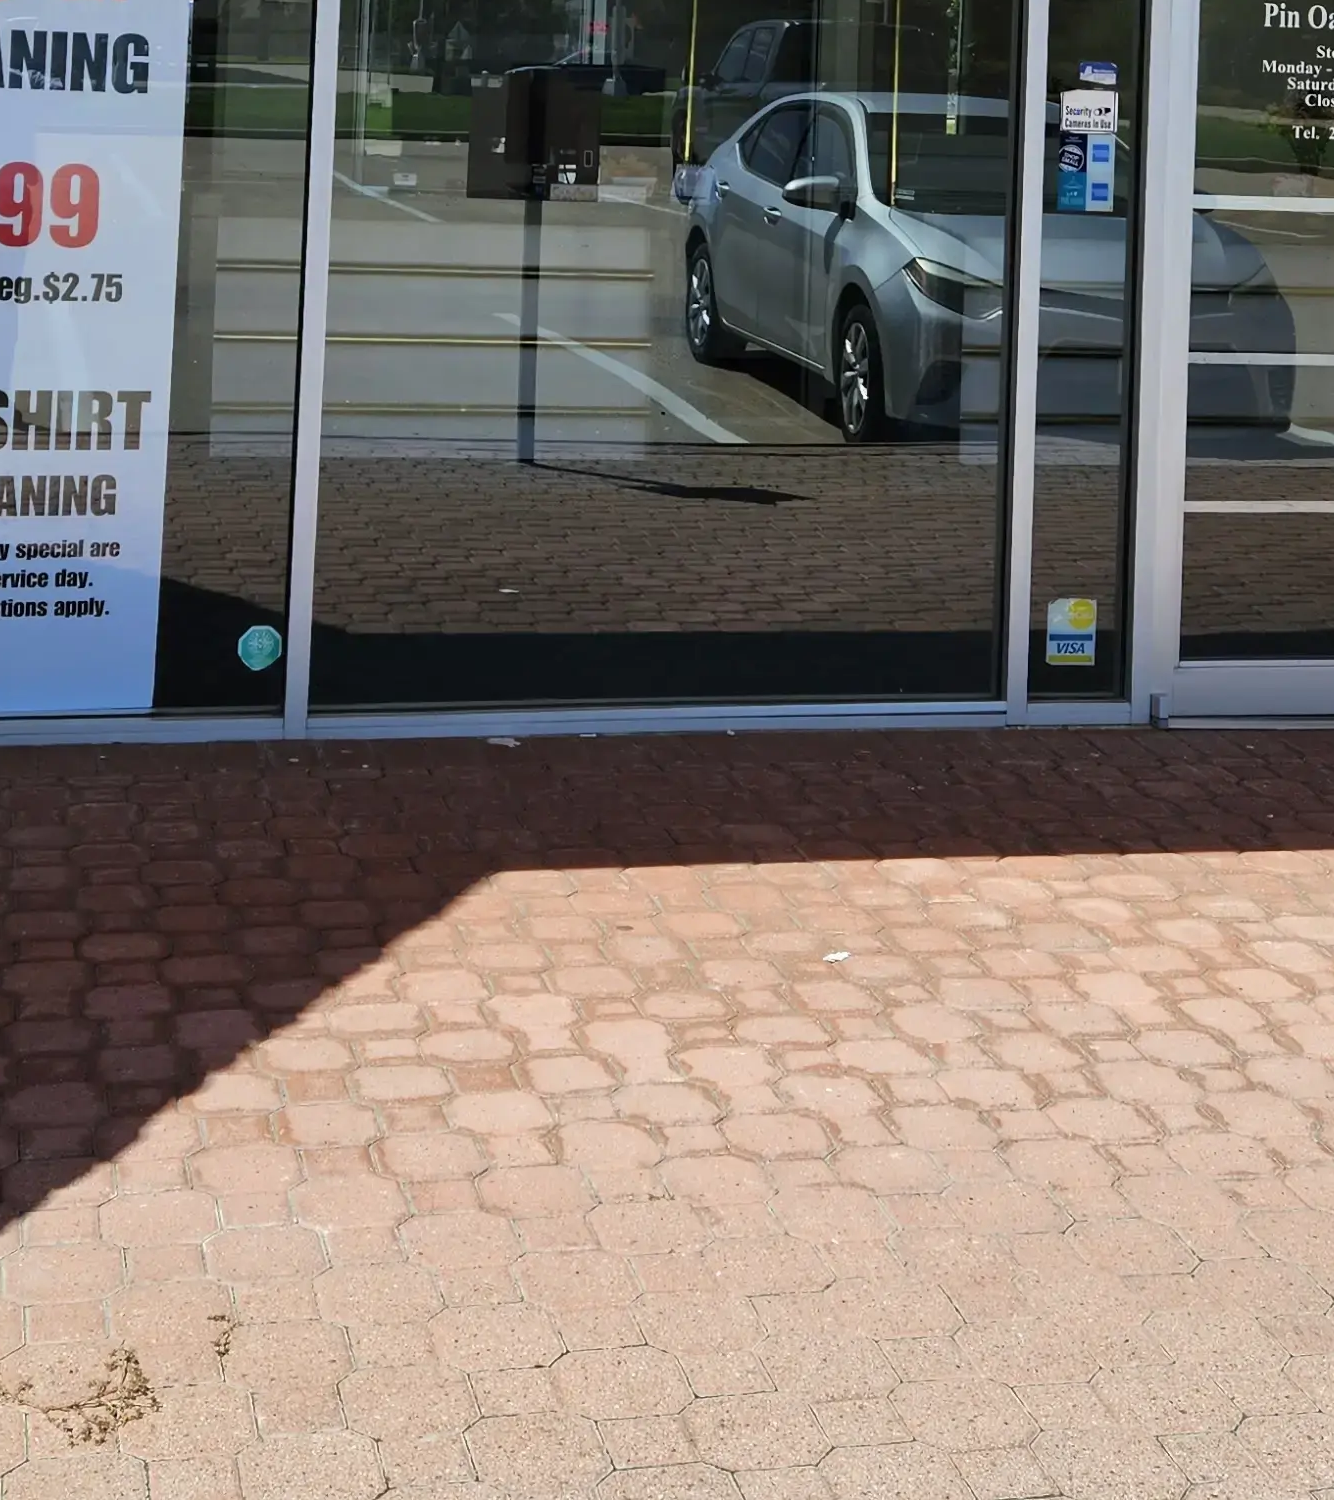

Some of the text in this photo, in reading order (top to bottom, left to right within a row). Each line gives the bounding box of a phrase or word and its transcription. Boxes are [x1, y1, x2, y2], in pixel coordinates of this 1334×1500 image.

[1264, 2, 1300, 28] Pin
[1262, 60, 1322, 79] Monday
[1066, 106, 1092, 118] Security
[1065, 118, 1091, 129] Cameras
[1100, 119, 1111, 129] Use
[1292, 126, 1319, 140] Tel.
[16, 540, 84, 561] special
[90, 542, 120, 557] are
[54, 570, 93, 591] day.
[54, 598, 109, 619] apply.
[1057, 643, 1085, 653] VISA
